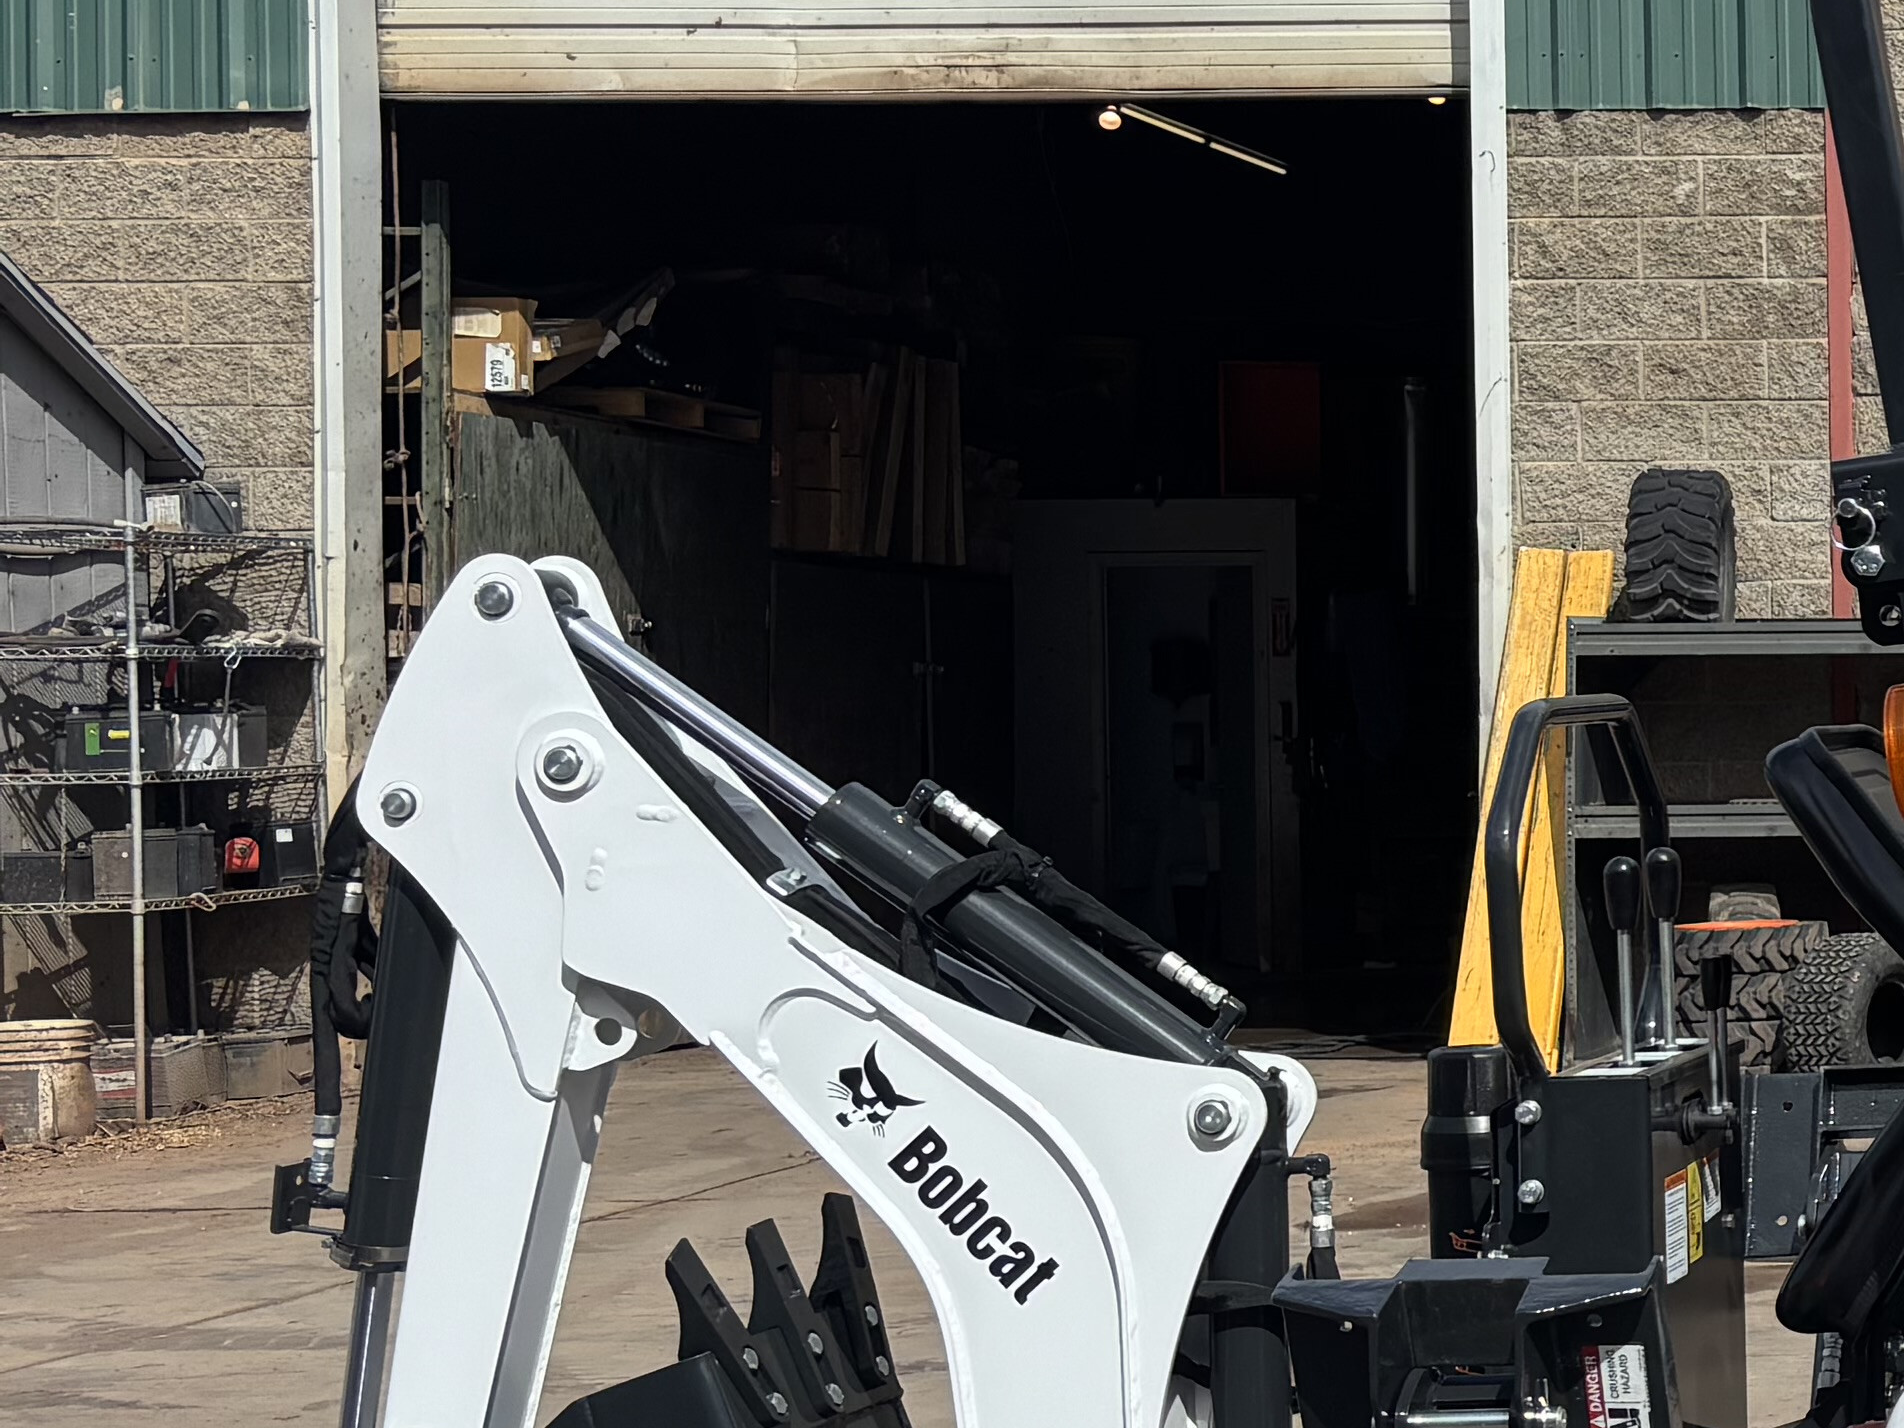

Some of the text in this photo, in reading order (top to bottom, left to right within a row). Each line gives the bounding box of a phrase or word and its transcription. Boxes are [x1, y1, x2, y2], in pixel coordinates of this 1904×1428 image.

[490, 359, 504, 388] 12579
[887, 1125, 1060, 1305] Bobcat
[1584, 1355, 1603, 1412] DANGER
[1606, 1349, 1620, 1399] CRUSHING
[1618, 1354, 1631, 1395] HAZARD
